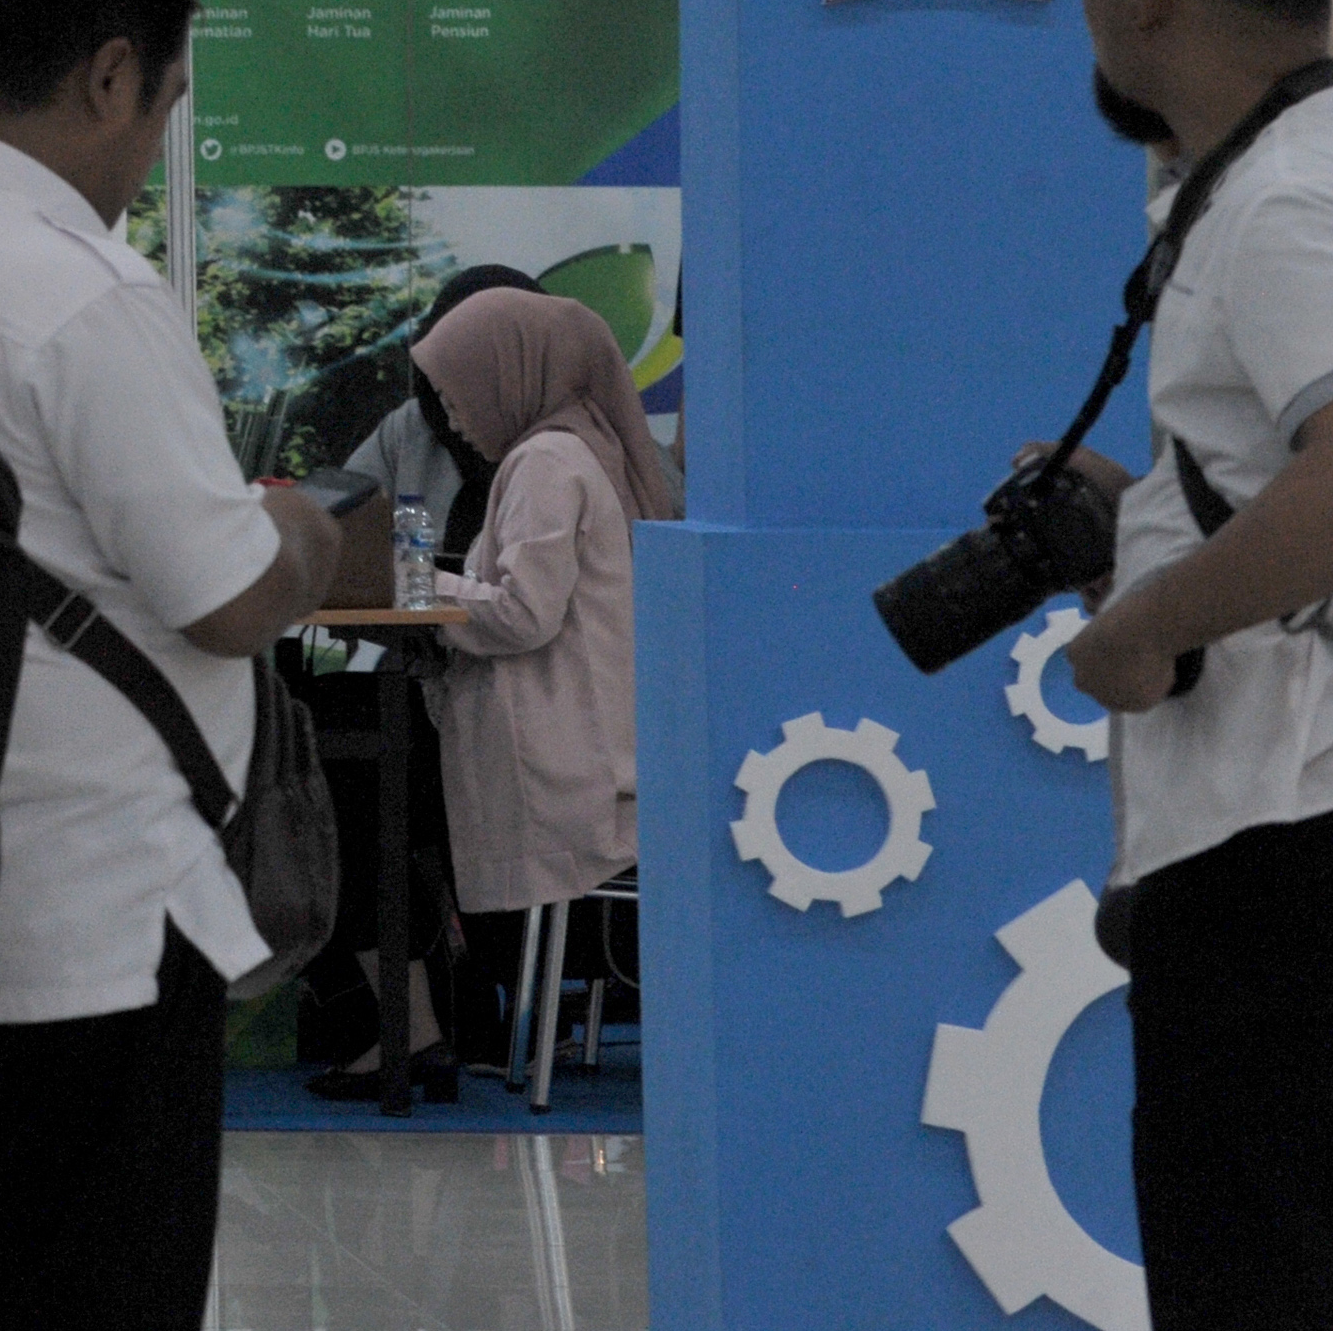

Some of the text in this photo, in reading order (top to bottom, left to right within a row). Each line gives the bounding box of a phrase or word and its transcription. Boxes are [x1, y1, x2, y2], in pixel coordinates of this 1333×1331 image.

[191, 7, 249, 20] aminan
[307, 6, 372, 20] Jaminan
[429, 6, 491, 20] Jaminan
[192, 25, 253, 39] ematian
[307, 24, 372, 39] Hari Tua
[430, 24, 490, 39] Pensiun
